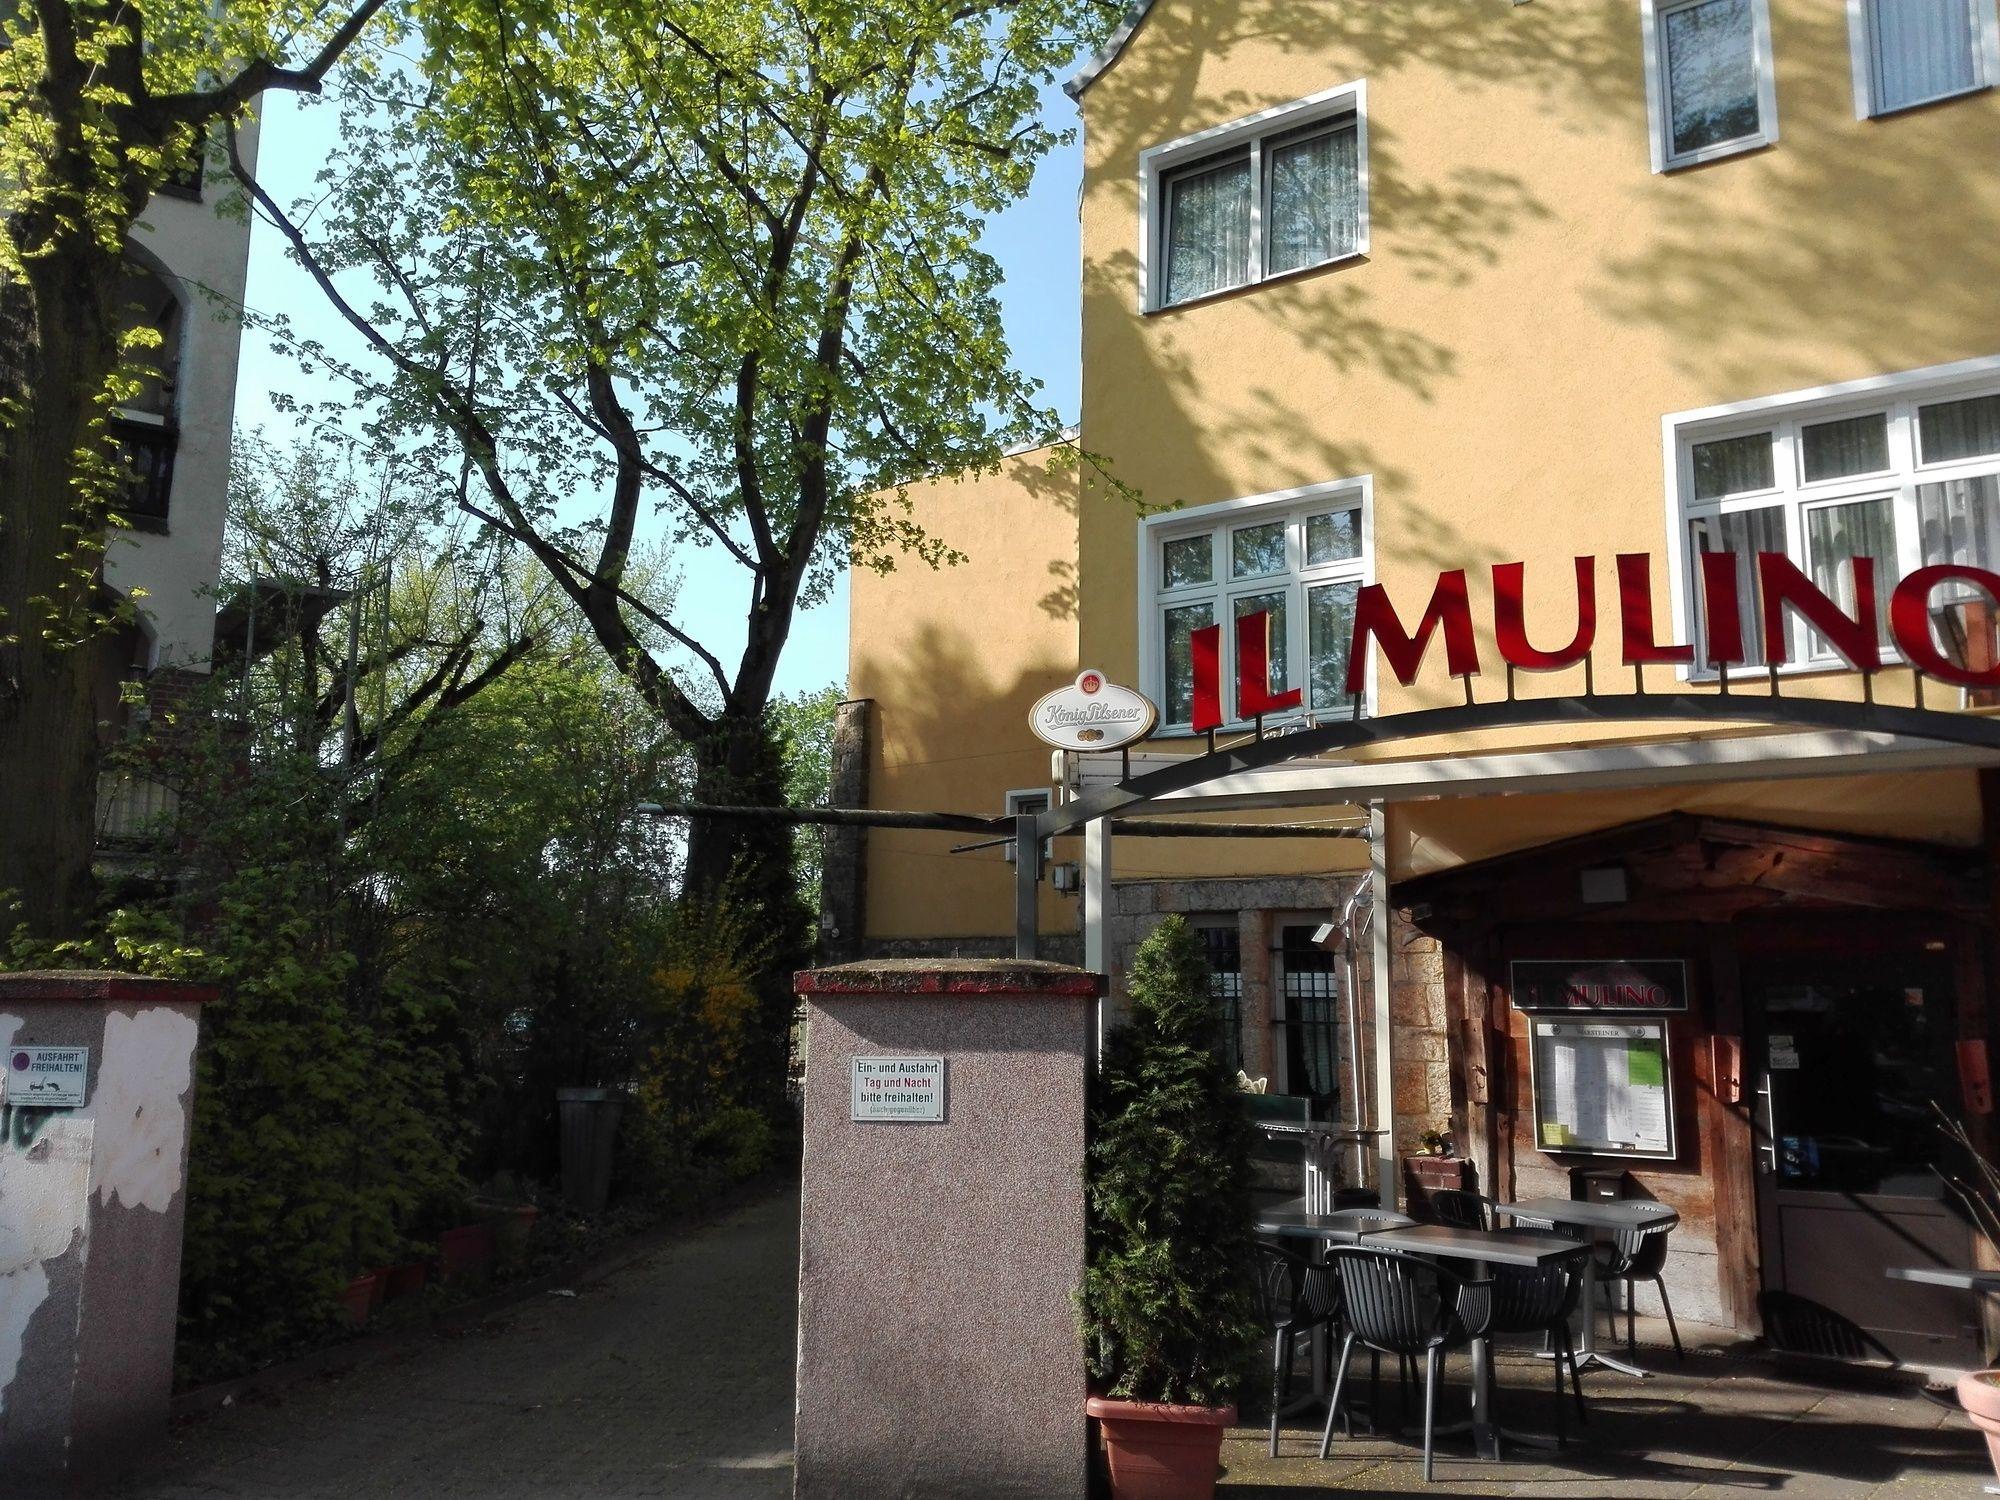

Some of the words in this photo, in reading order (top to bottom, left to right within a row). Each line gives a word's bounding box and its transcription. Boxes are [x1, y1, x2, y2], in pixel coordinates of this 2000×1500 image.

[1190, 609, 1303, 734] IL
[1345, 552, 2000, 694] MULINO
[1045, 704, 1088, 726] König
[1085, 702, 1141, 721] Pilsener
[36, 1052, 80, 1062] AUSFAHRT
[31, 1063, 83, 1073] FREIHALTEN!
[857, 1062, 876, 1073] Ein-
[879, 1062, 896, 1073] und
[899, 1062, 938, 1073] Ausfahrt
[864, 1077, 881, 1089] Tag
[884, 1077, 901, 1088] und
[904, 1077, 931, 1088] Nacht
[861, 1092, 882, 1103] bitte
[884, 1092, 934, 1103] freihalten!
